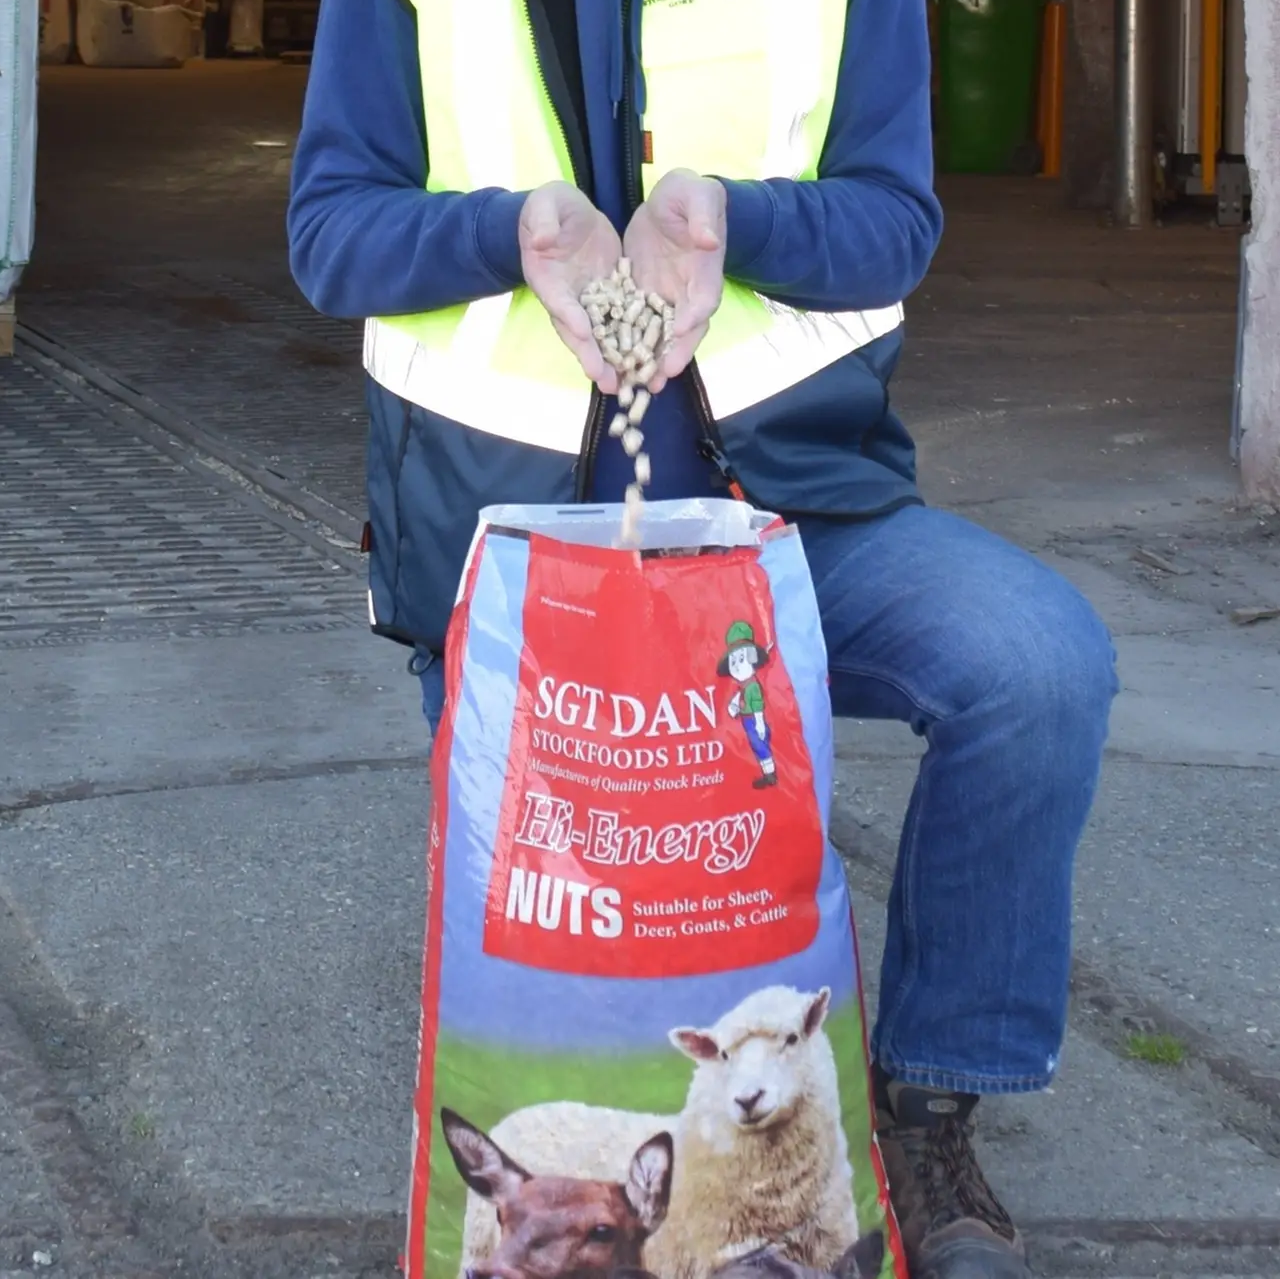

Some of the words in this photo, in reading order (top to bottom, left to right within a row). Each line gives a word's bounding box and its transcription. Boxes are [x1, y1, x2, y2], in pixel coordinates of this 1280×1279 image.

[534, 676, 604, 731] SGT
[610, 685, 717, 738] DAN
[532, 729, 669, 769] STOCKFOODS
[676, 740, 724, 766] LTD
[530, 758, 595, 786] Manufacturers
[590, 776, 603, 791] of
[602, 778, 650, 796] Quality
[653, 776, 688, 791] Stock
[691, 770, 724, 787] Feeds
[515, 792, 765, 874] Hi-Energy
[505, 866, 624, 939] NUTS
[632, 896, 698, 917] Suitable
[702, 897, 725, 911] for
[727, 887, 773, 907] Sheep,
[634, 923, 677, 939] Deer,
[680, 917, 731, 936] Goats,
[733, 915, 746, 928] &
[749, 904, 789, 924] Cattle
